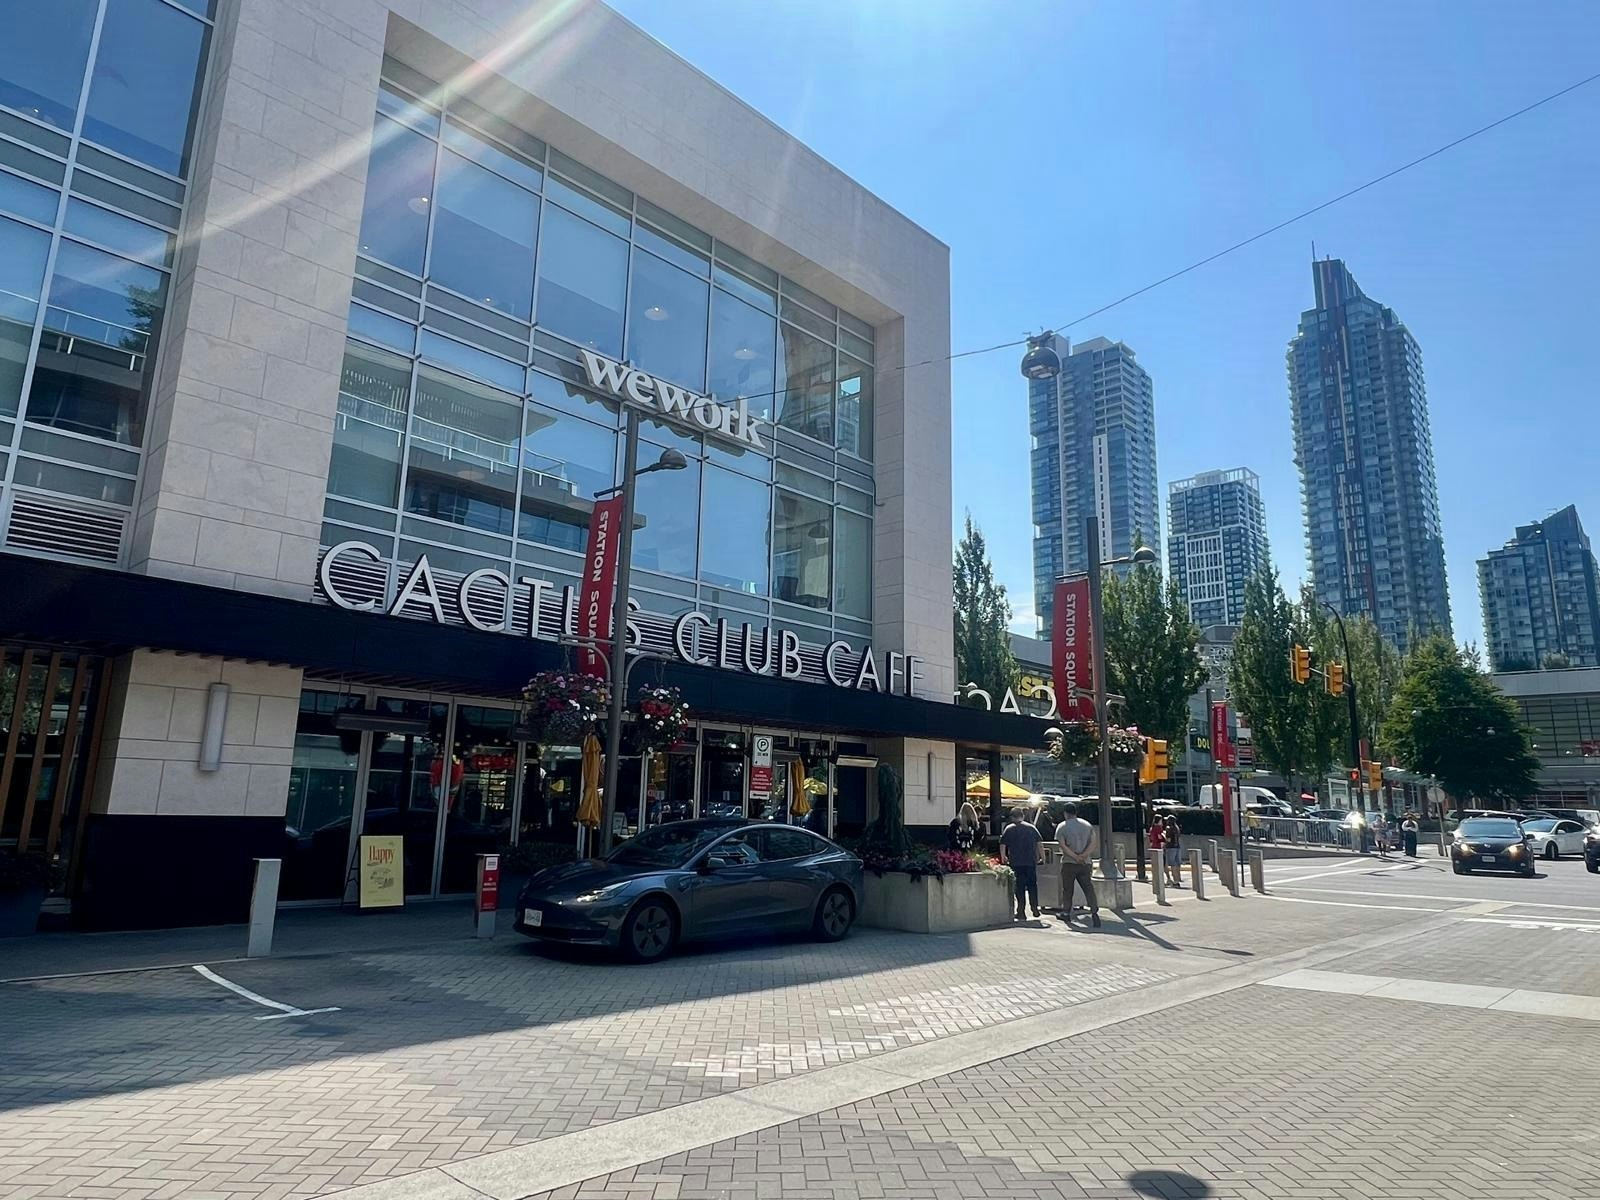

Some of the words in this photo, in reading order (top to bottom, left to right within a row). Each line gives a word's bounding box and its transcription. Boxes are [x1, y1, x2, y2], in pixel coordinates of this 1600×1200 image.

[581, 349, 766, 449] wework
[592, 510, 609, 583] STATION
[672, 611, 803, 678] CLUB
[1065, 593, 1077, 647] STATION
[1064, 651, 1078, 707] SQUARE
[369, 845, 394, 864] Happy
